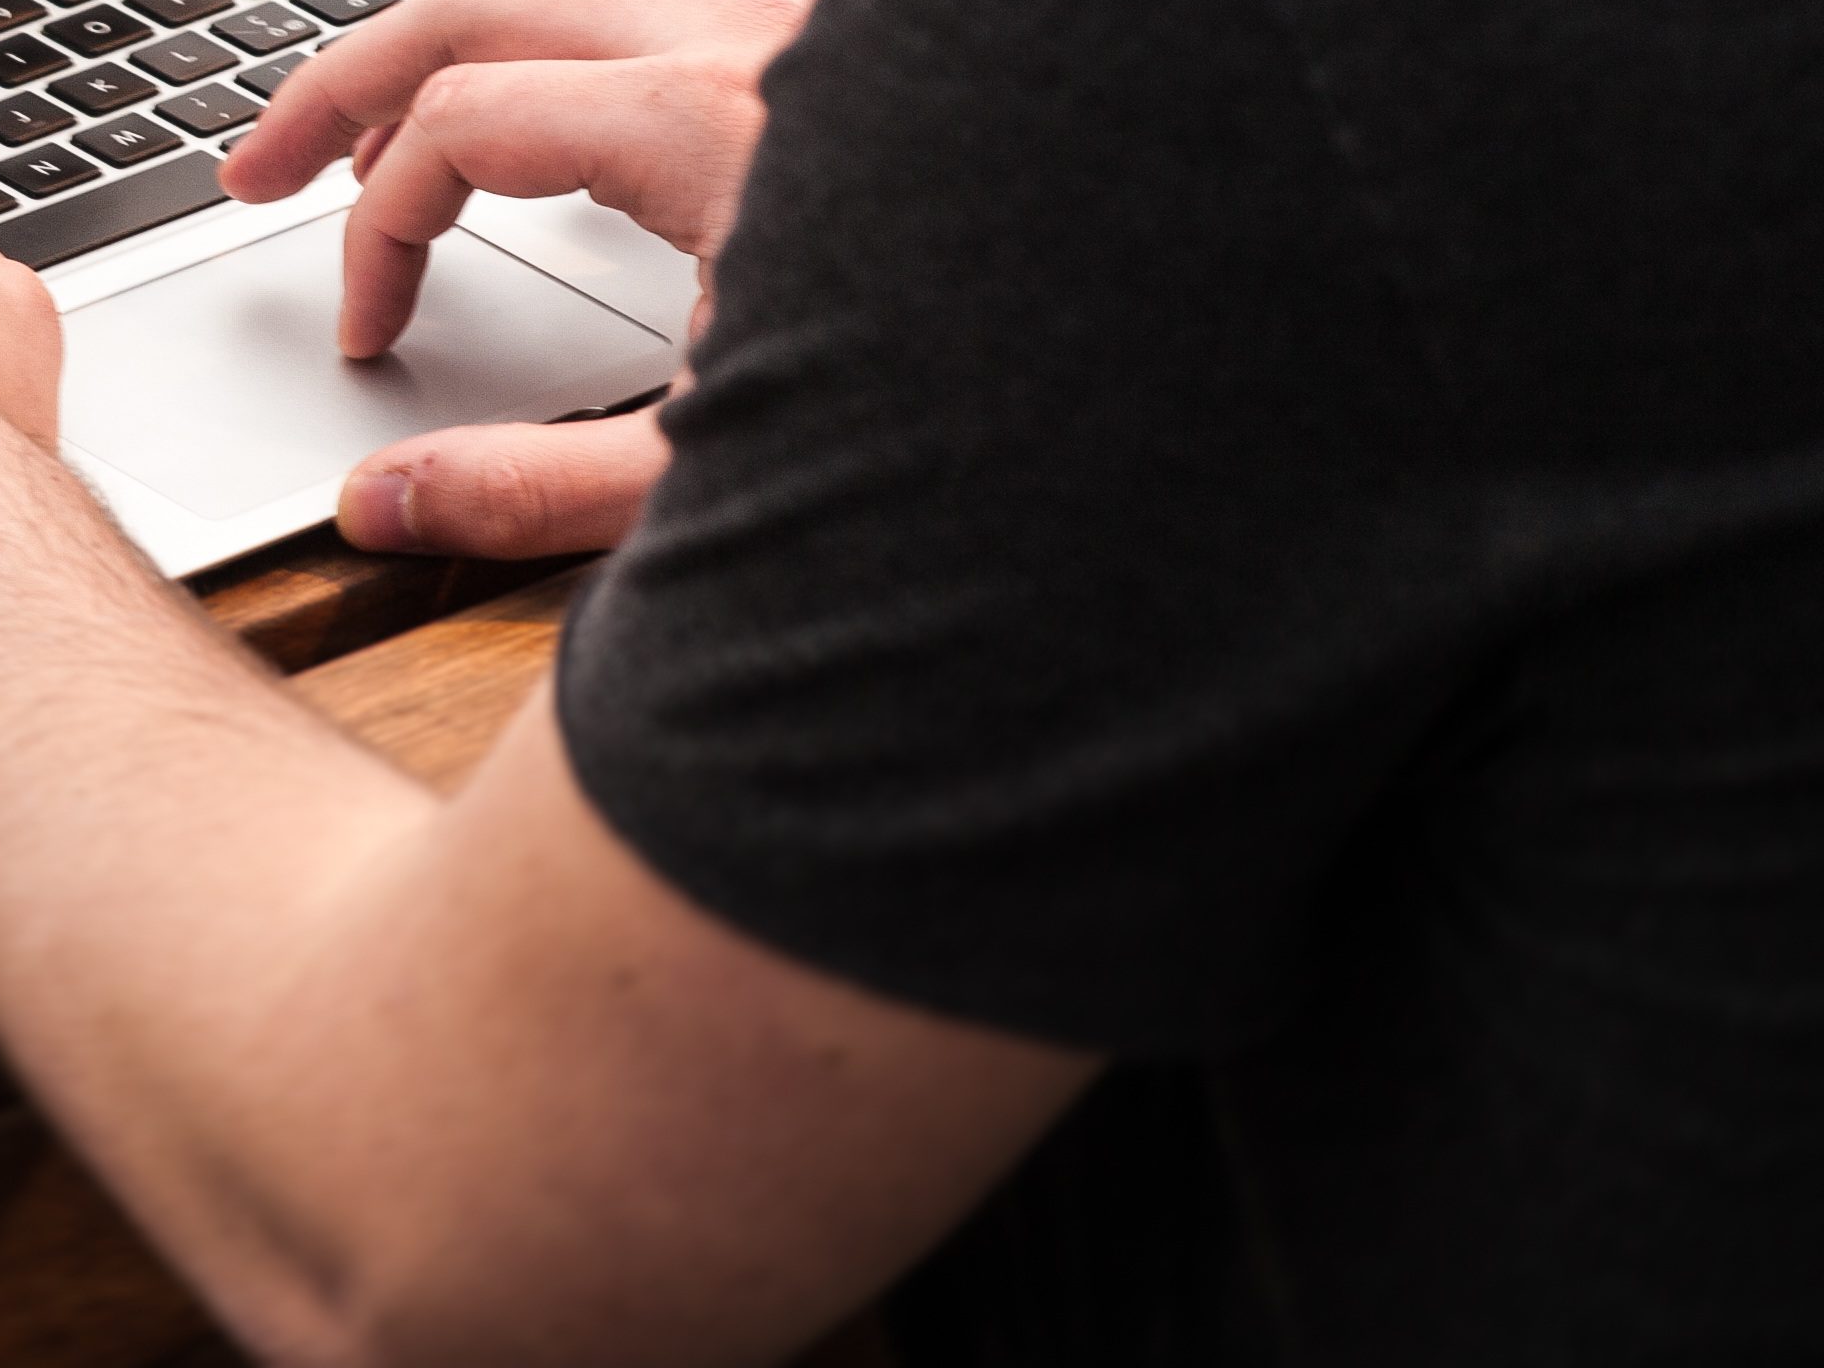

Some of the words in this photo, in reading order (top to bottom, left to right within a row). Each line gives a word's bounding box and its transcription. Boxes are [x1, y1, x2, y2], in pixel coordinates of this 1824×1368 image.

[82, 21, 112, 34] O
[87, 78, 119, 93] K
[28, 159, 61, 176] N
[110, 130, 147, 147] M
